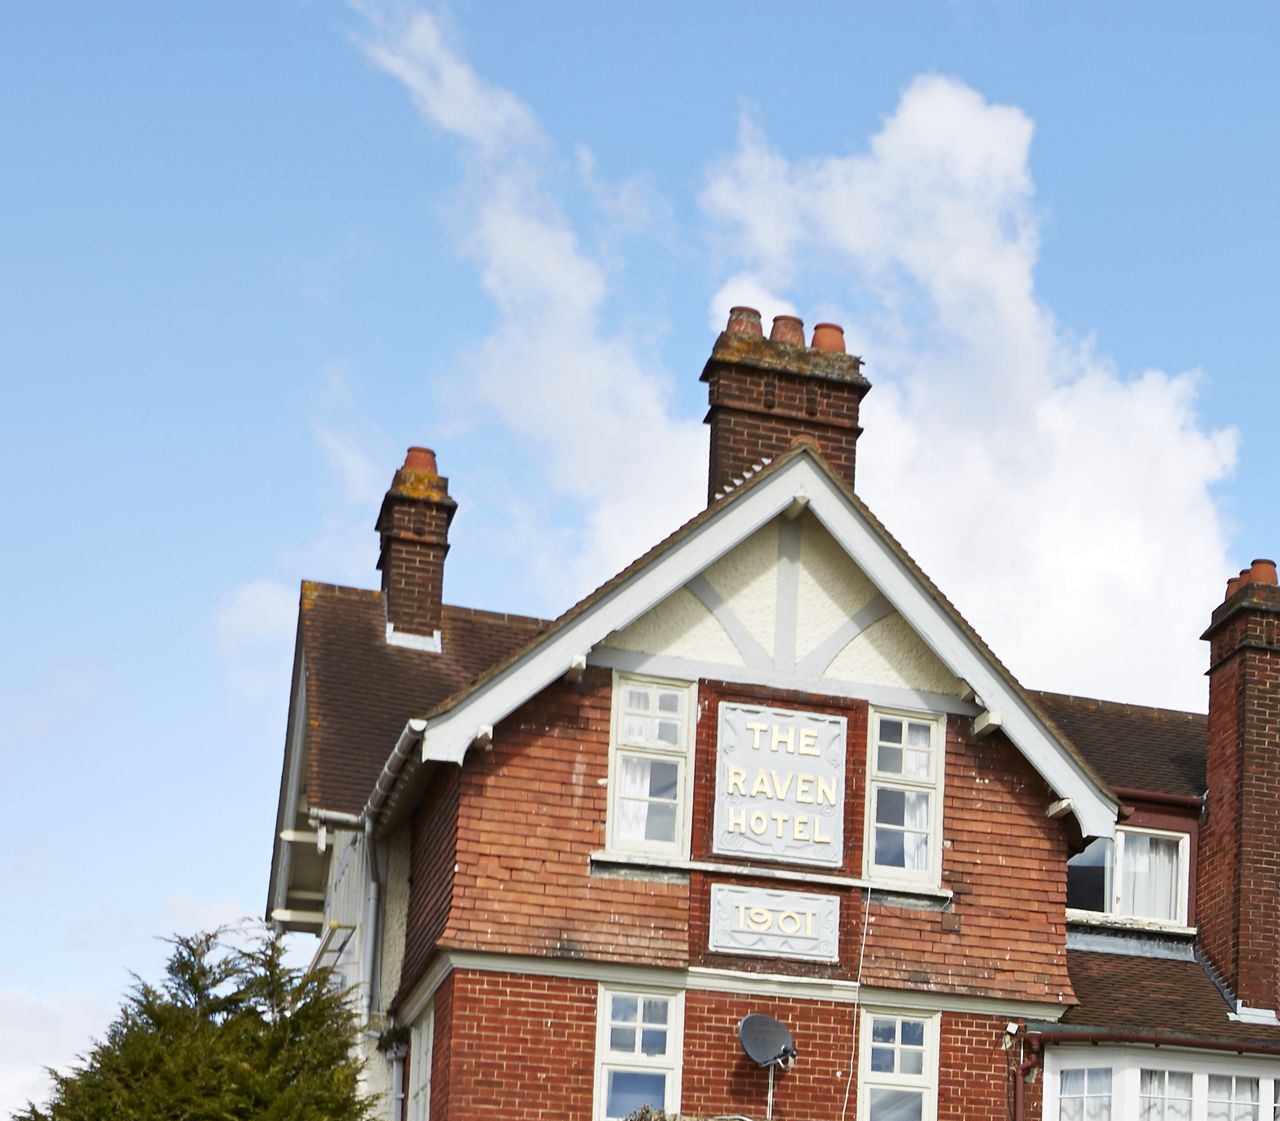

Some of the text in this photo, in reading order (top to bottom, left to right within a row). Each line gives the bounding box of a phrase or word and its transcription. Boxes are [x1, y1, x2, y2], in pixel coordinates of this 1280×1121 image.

[746, 722, 821, 757] THE
[727, 766, 837, 807] RAVEN
[727, 806, 831, 844] HOTEL
[738, 904, 814, 938] 1901
